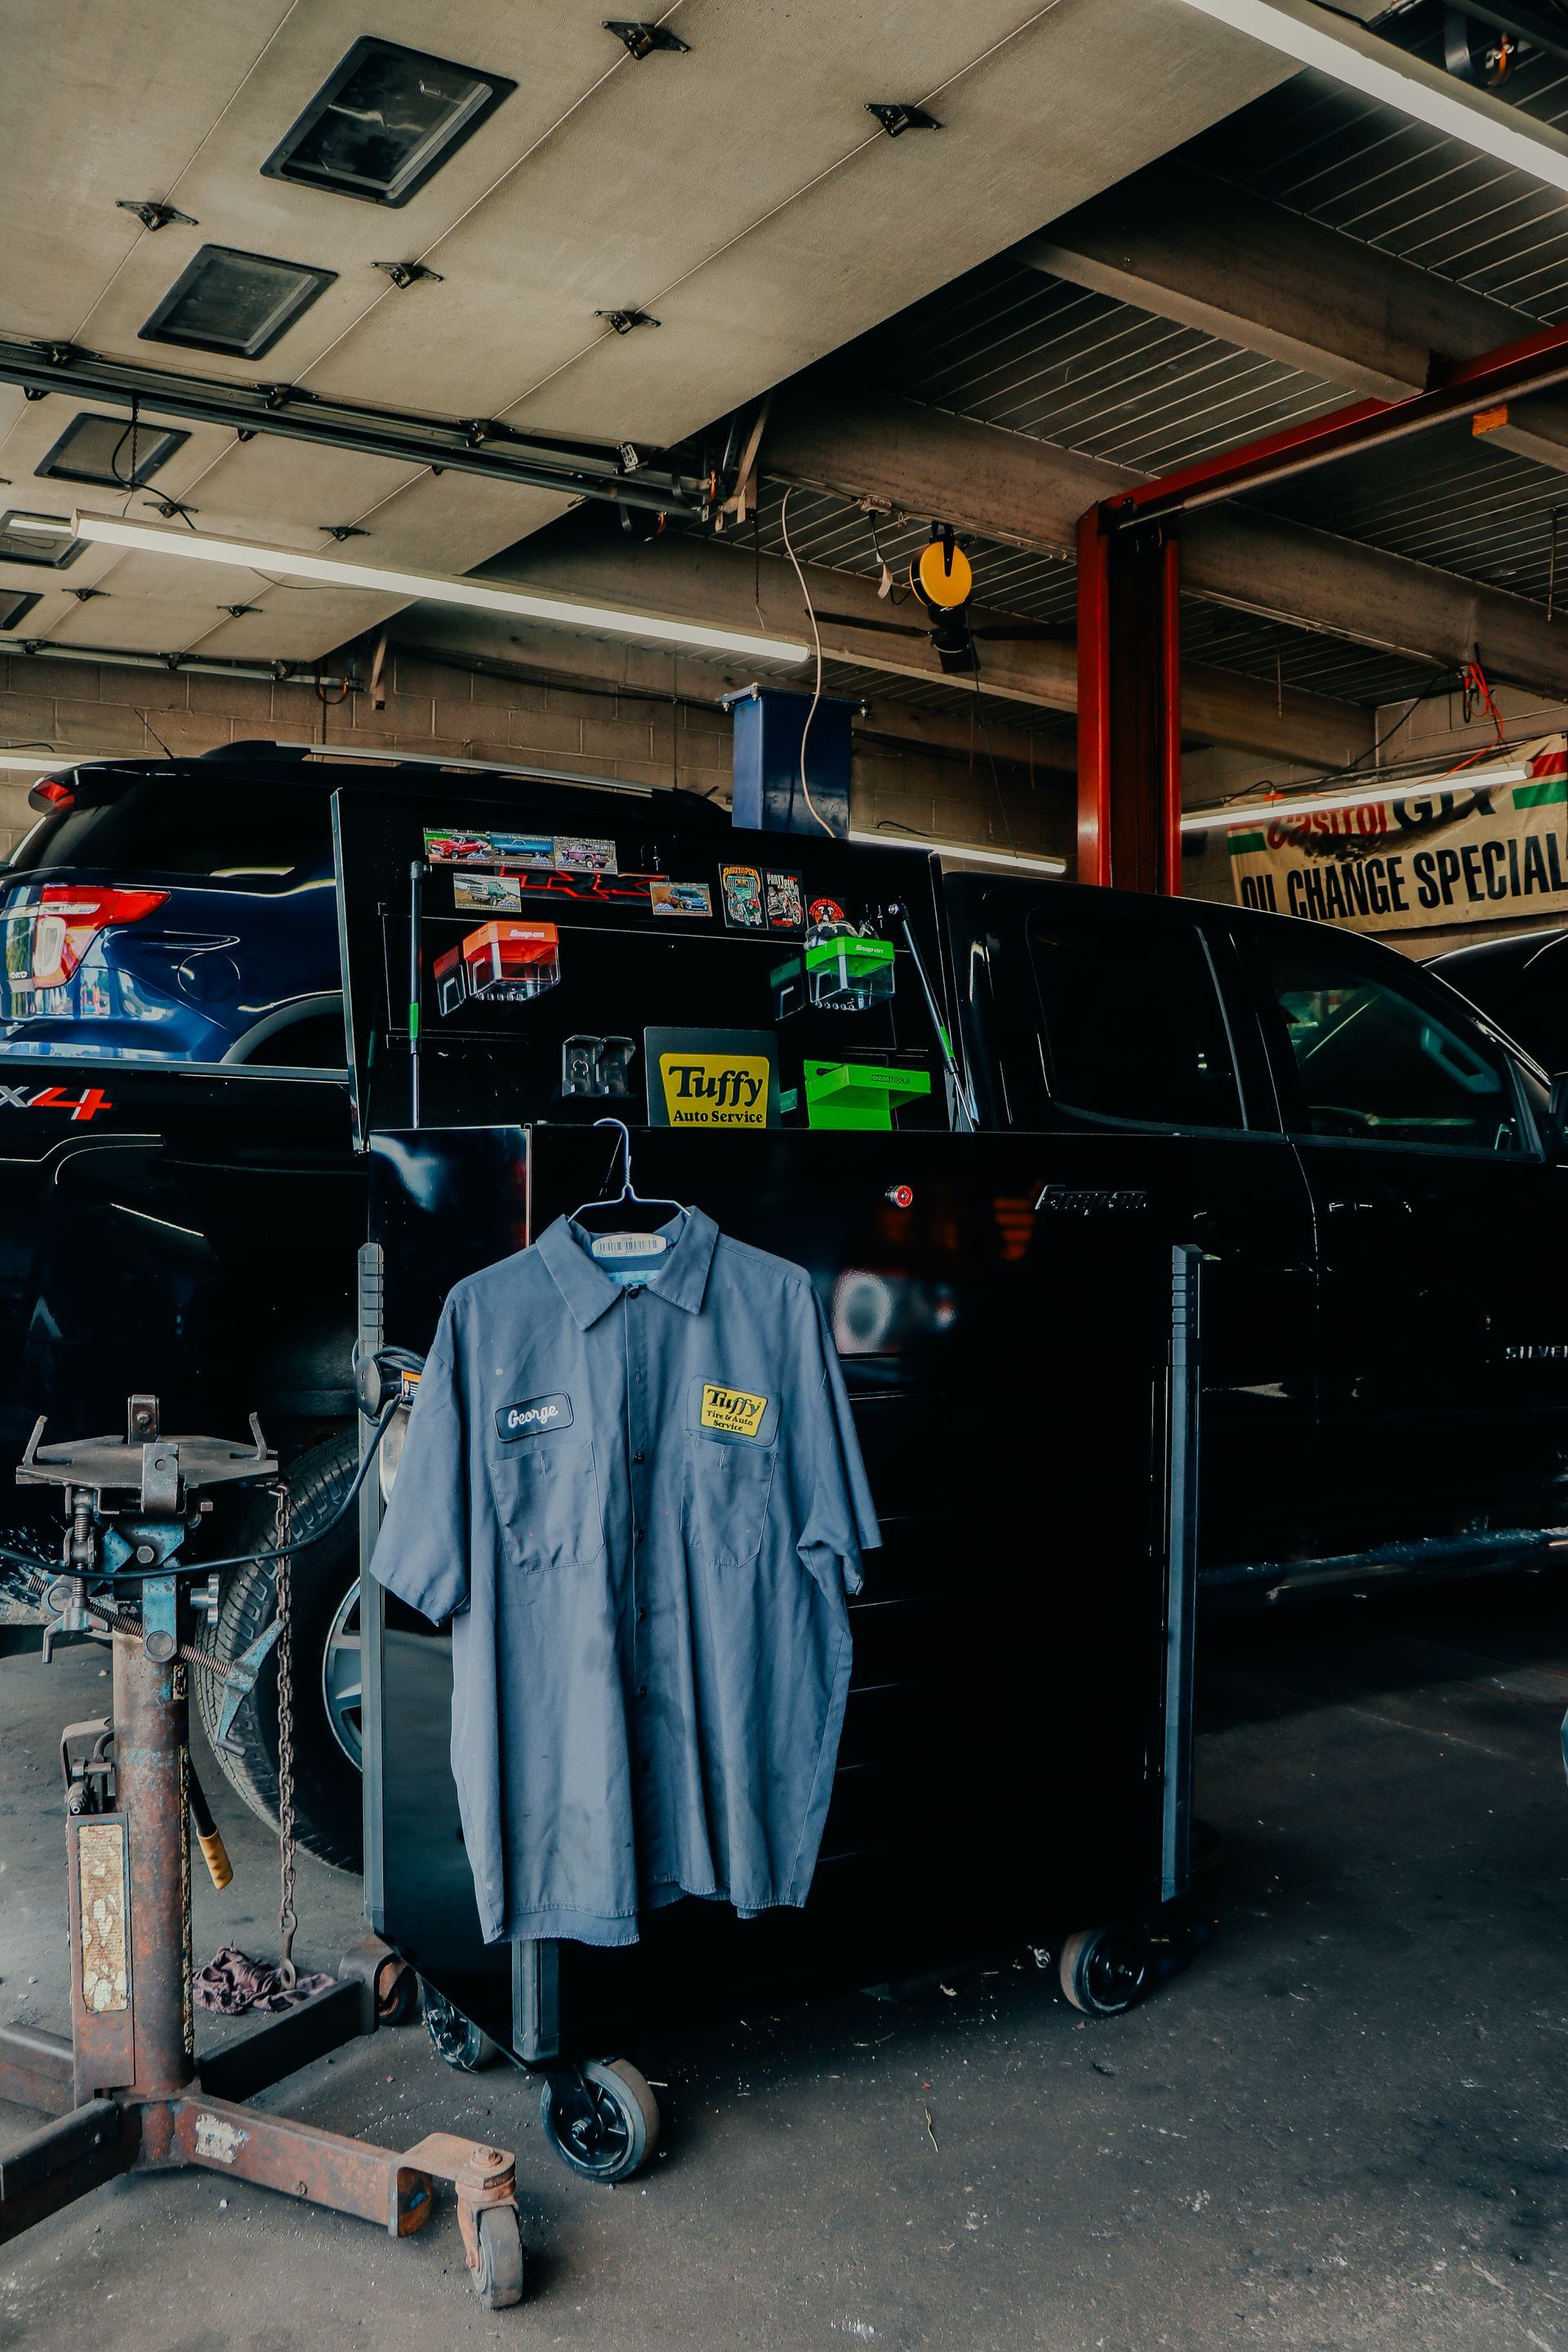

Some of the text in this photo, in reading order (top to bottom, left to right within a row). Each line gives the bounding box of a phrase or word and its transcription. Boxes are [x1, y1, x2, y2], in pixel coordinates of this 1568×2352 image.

[767, 875, 784, 884] PARTY
[1287, 857, 1410, 920] CHANGE
[1414, 833, 1568, 909] SPECIAL
[509, 929, 546, 938] Snap-on
[855, 944, 884, 954] Snap-on
[668, 1066, 764, 1107] Tuffy
[673, 1109, 764, 1123] Auto Service
[1504, 1345, 1568, 1359] SILVE
[707, 1388, 760, 1417] Tuffy
[508, 1405, 559, 1428] George
[706, 1410, 724, 1420] Tire
[732, 1416, 753, 1427] Auto
[713, 1419, 743, 1432] Service
